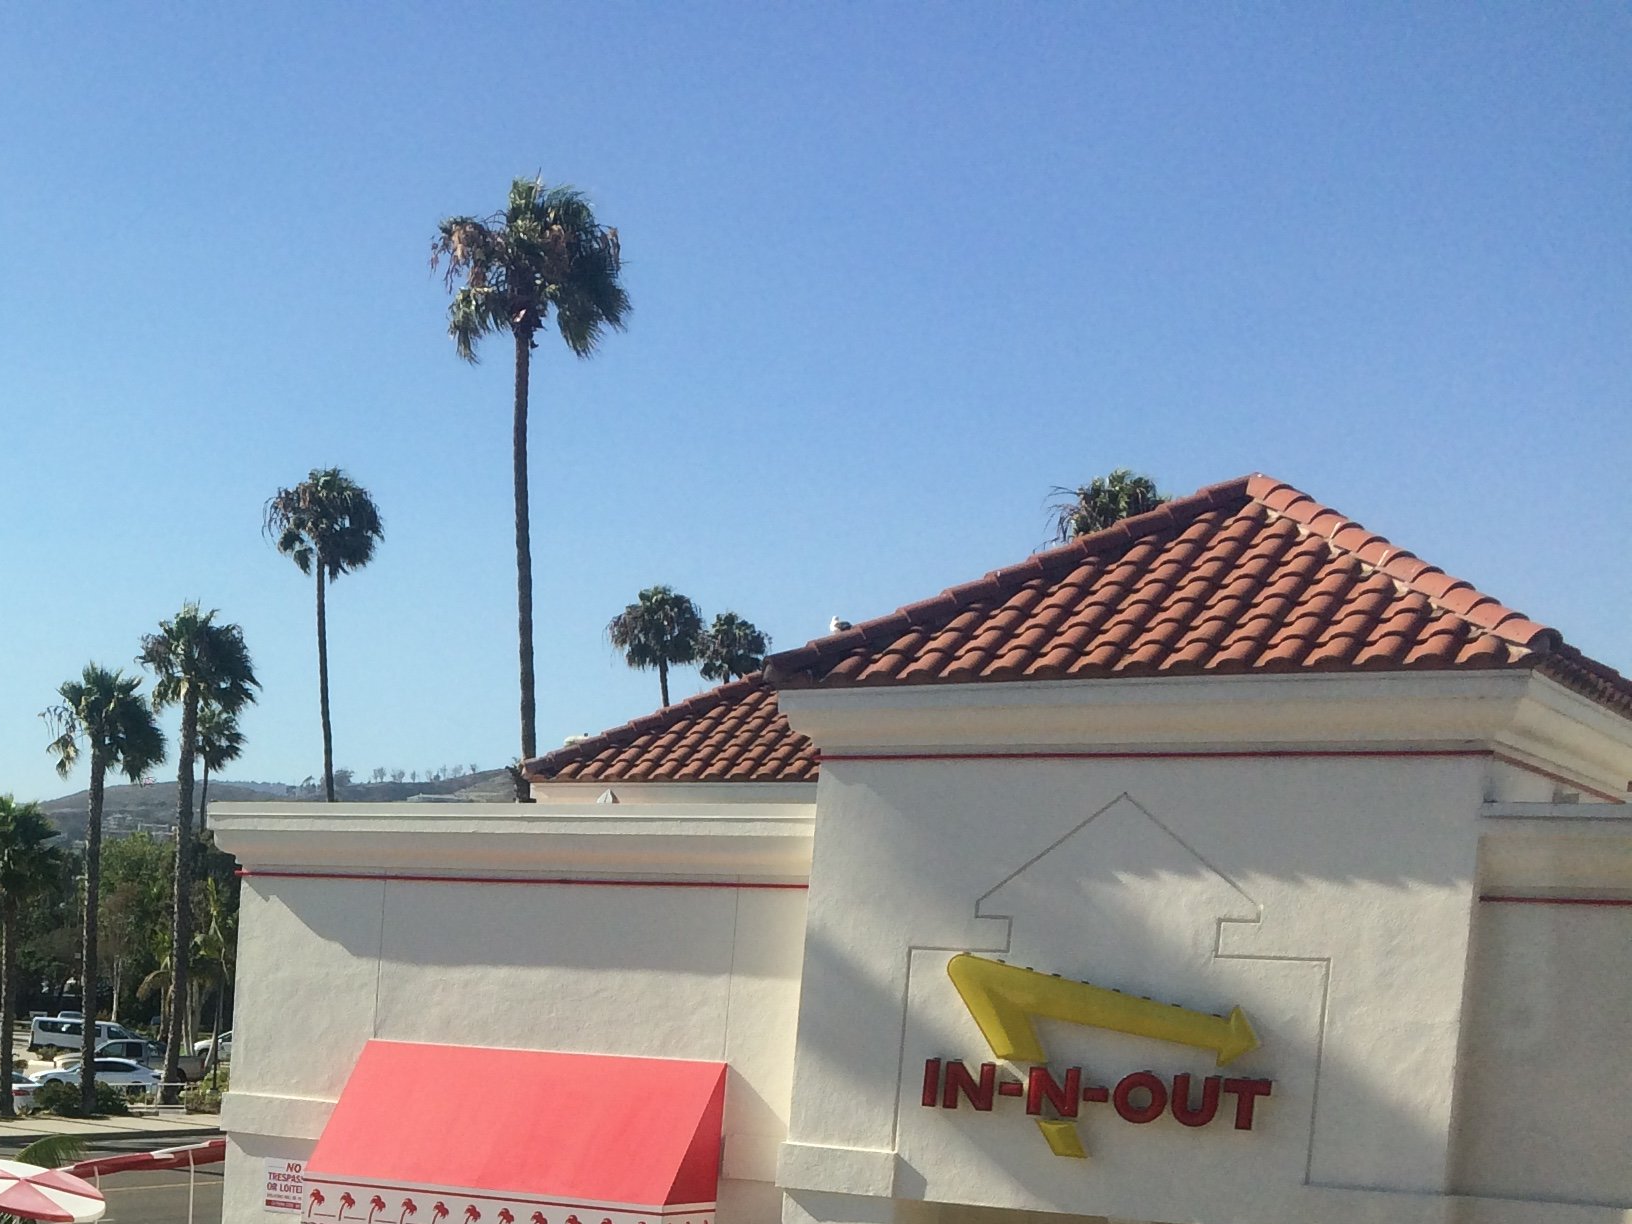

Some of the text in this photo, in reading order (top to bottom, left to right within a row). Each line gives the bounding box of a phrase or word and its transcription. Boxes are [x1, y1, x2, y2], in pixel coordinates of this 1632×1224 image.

[921, 1057, 1273, 1131] IN-N-OUT
[286, 1162, 302, 1173] NO
[268, 1171, 303, 1184] TRESPAS
[266, 1182, 303, 1194] OR LOITE
